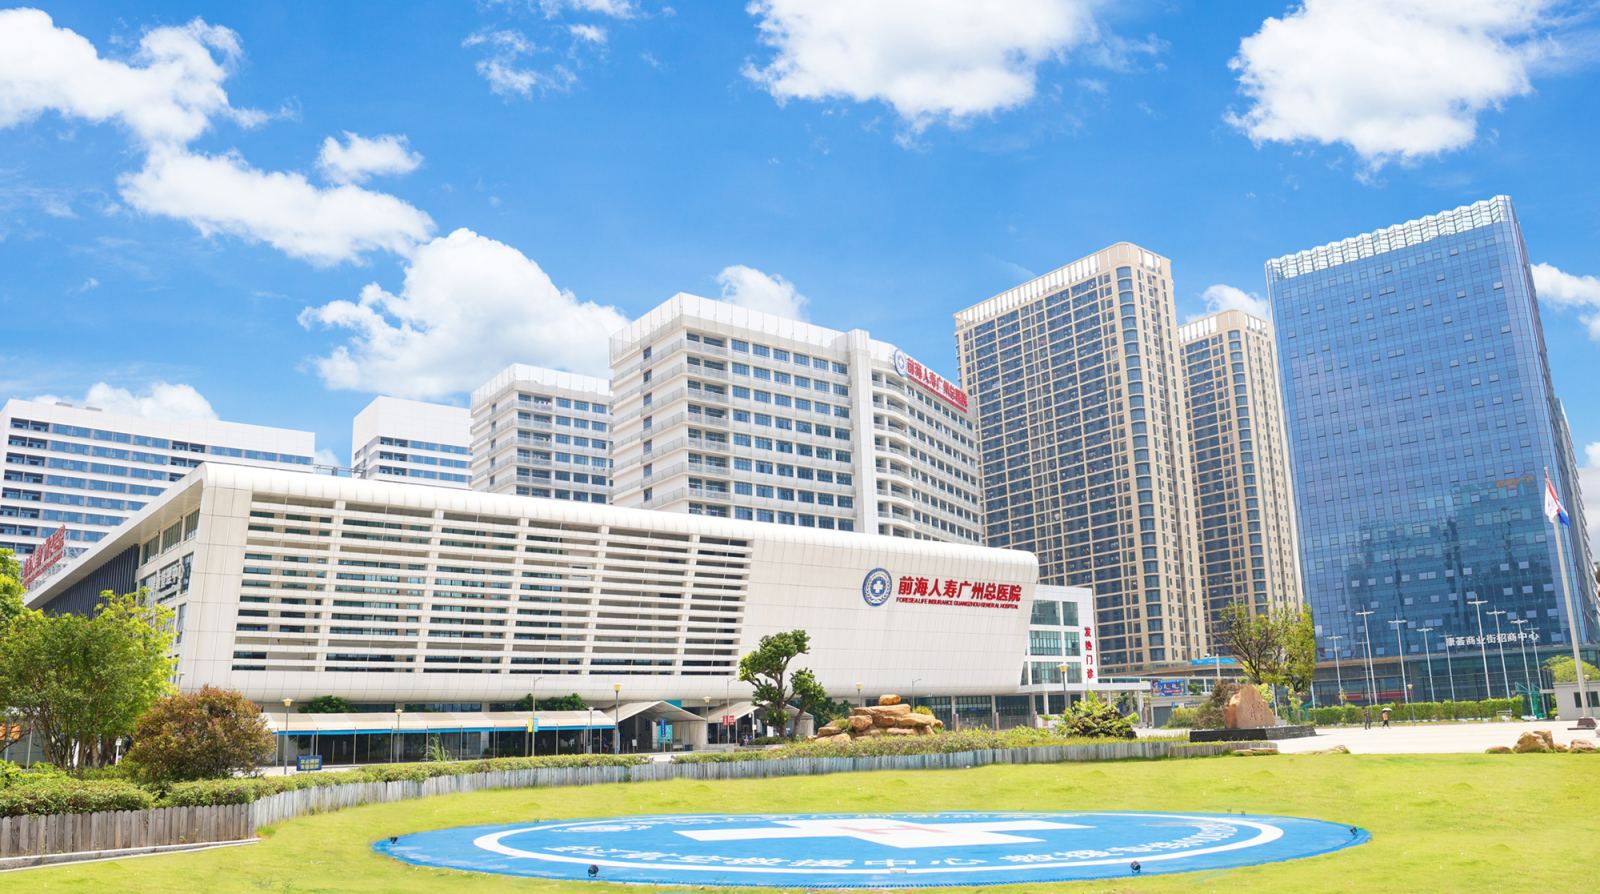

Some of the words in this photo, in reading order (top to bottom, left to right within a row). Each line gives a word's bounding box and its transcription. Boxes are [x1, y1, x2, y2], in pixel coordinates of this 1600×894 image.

[898, 576, 1022, 602] 前海人寿广州总医院
[1084, 626, 1093, 679] 发热门诊
